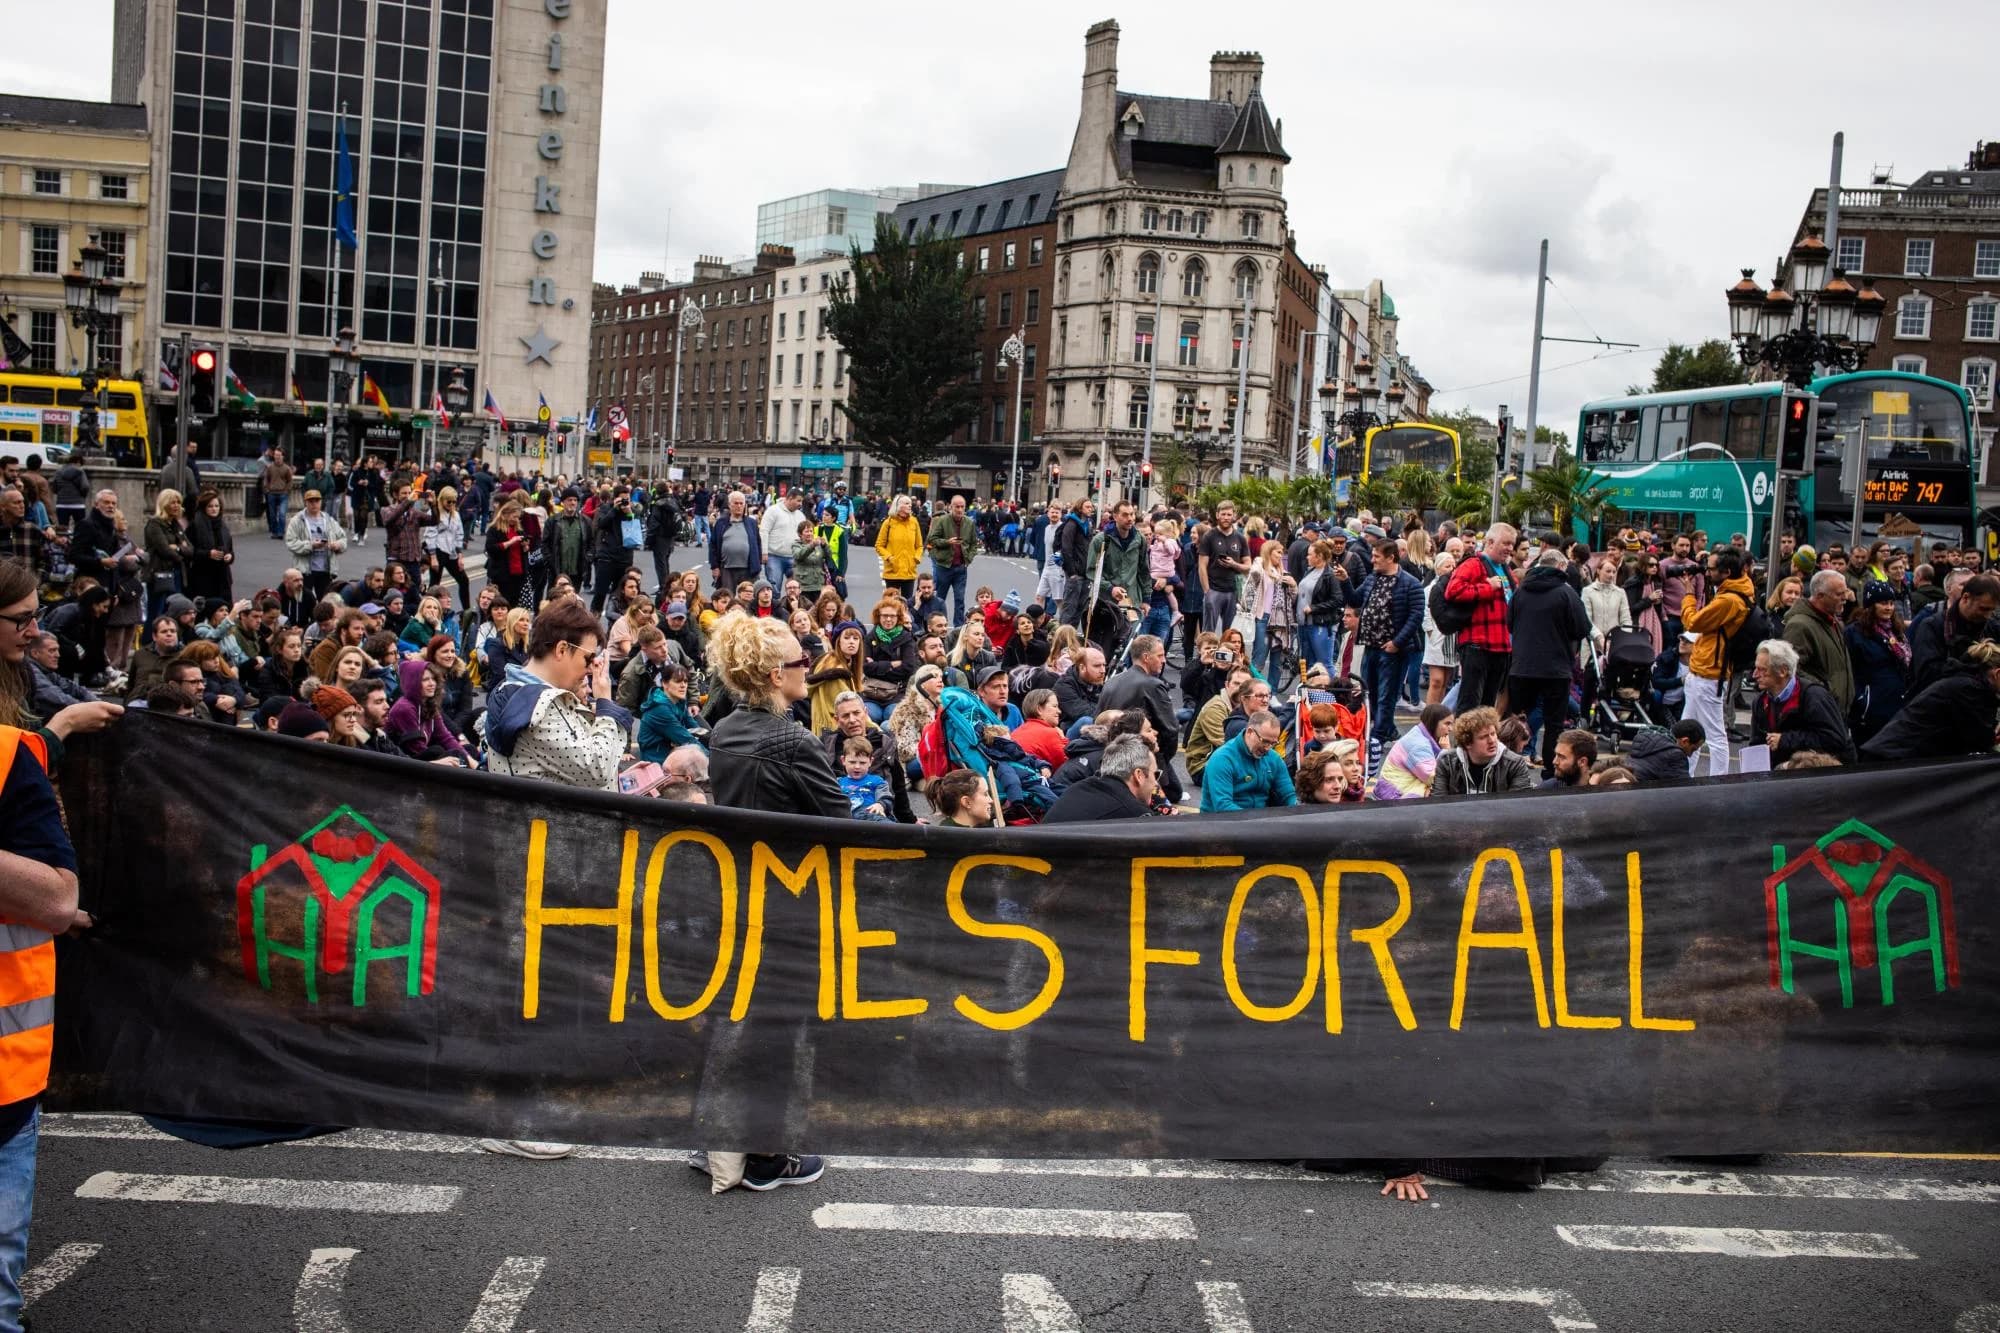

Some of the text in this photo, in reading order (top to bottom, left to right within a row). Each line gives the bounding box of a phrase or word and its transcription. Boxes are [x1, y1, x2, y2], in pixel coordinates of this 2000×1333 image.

[44, 413, 69, 422] SOLD
[1882, 470, 1909, 480] Airlink
[1690, 486, 1709, 502] airport
[1712, 485, 1724, 503] city
[1916, 482, 1944, 503] 747
[523, 819, 1696, 1042] HOMES FOR ALL
